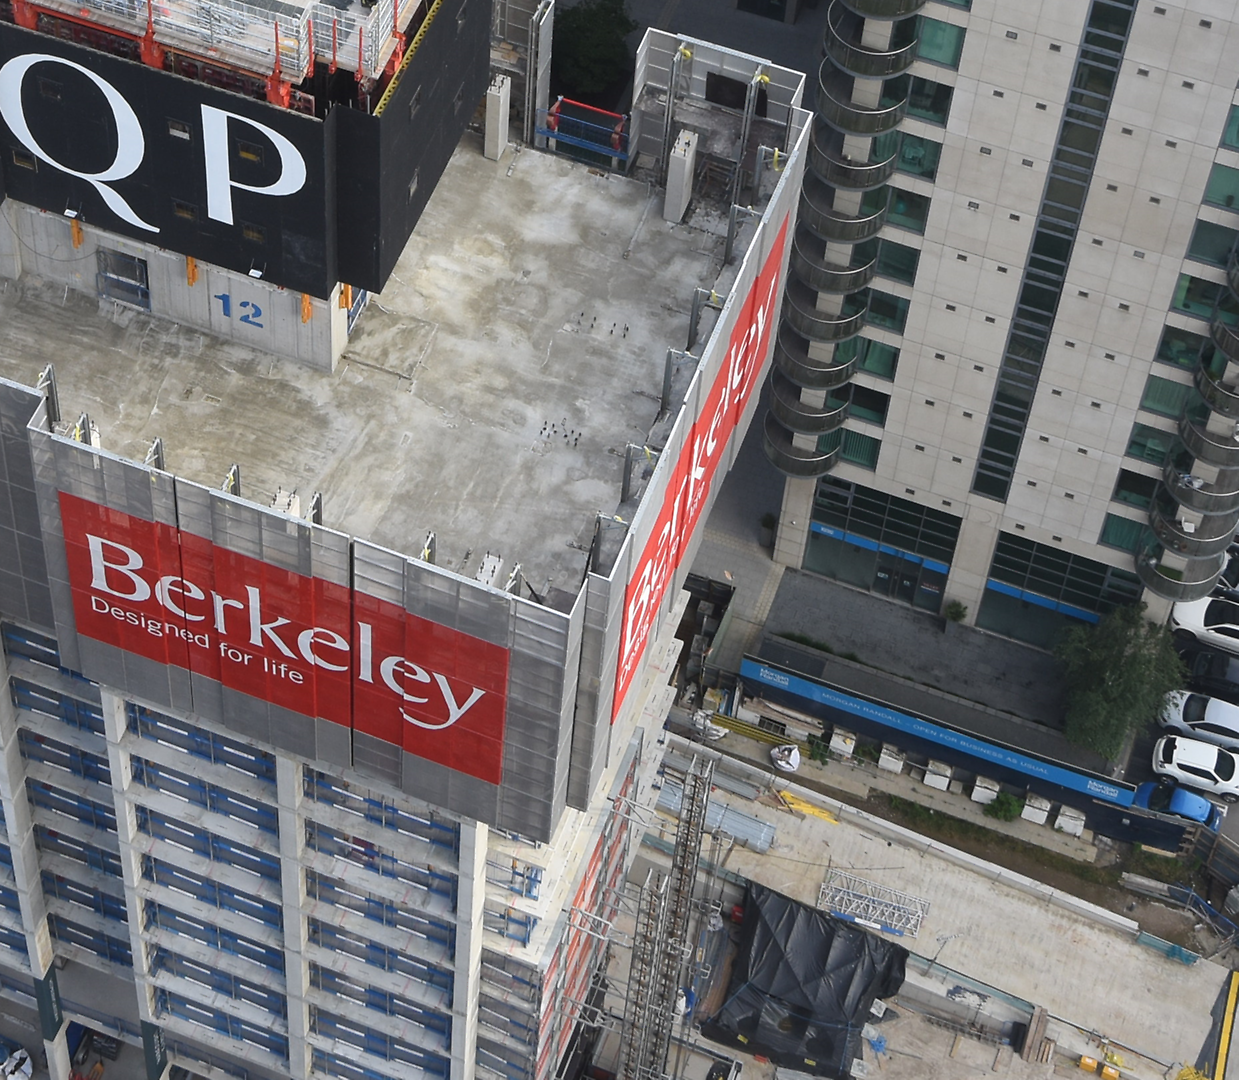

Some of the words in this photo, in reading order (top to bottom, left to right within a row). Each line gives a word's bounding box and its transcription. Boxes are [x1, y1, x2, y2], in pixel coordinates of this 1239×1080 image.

[214, 293, 263, 328] 12
[621, 272, 777, 666] Berkeley
[85, 533, 486, 731] Berkeley
[91, 596, 210, 650] Designed
[219, 641, 253, 666] for
[263, 657, 304, 685] life
[760, 668, 790, 683] Morgan
[822, 692, 860, 710] MORGAN
[863, 706, 902, 724] RANDALL
[913, 723, 937, 737] OPEN
[939, 733, 958, 744] FOR
[960, 740, 1003, 760] BUSINESS
[1006, 756, 1018, 765] AS
[1020, 761, 1049, 775] USUAL
[1088, 780, 1119, 794] Morgan
